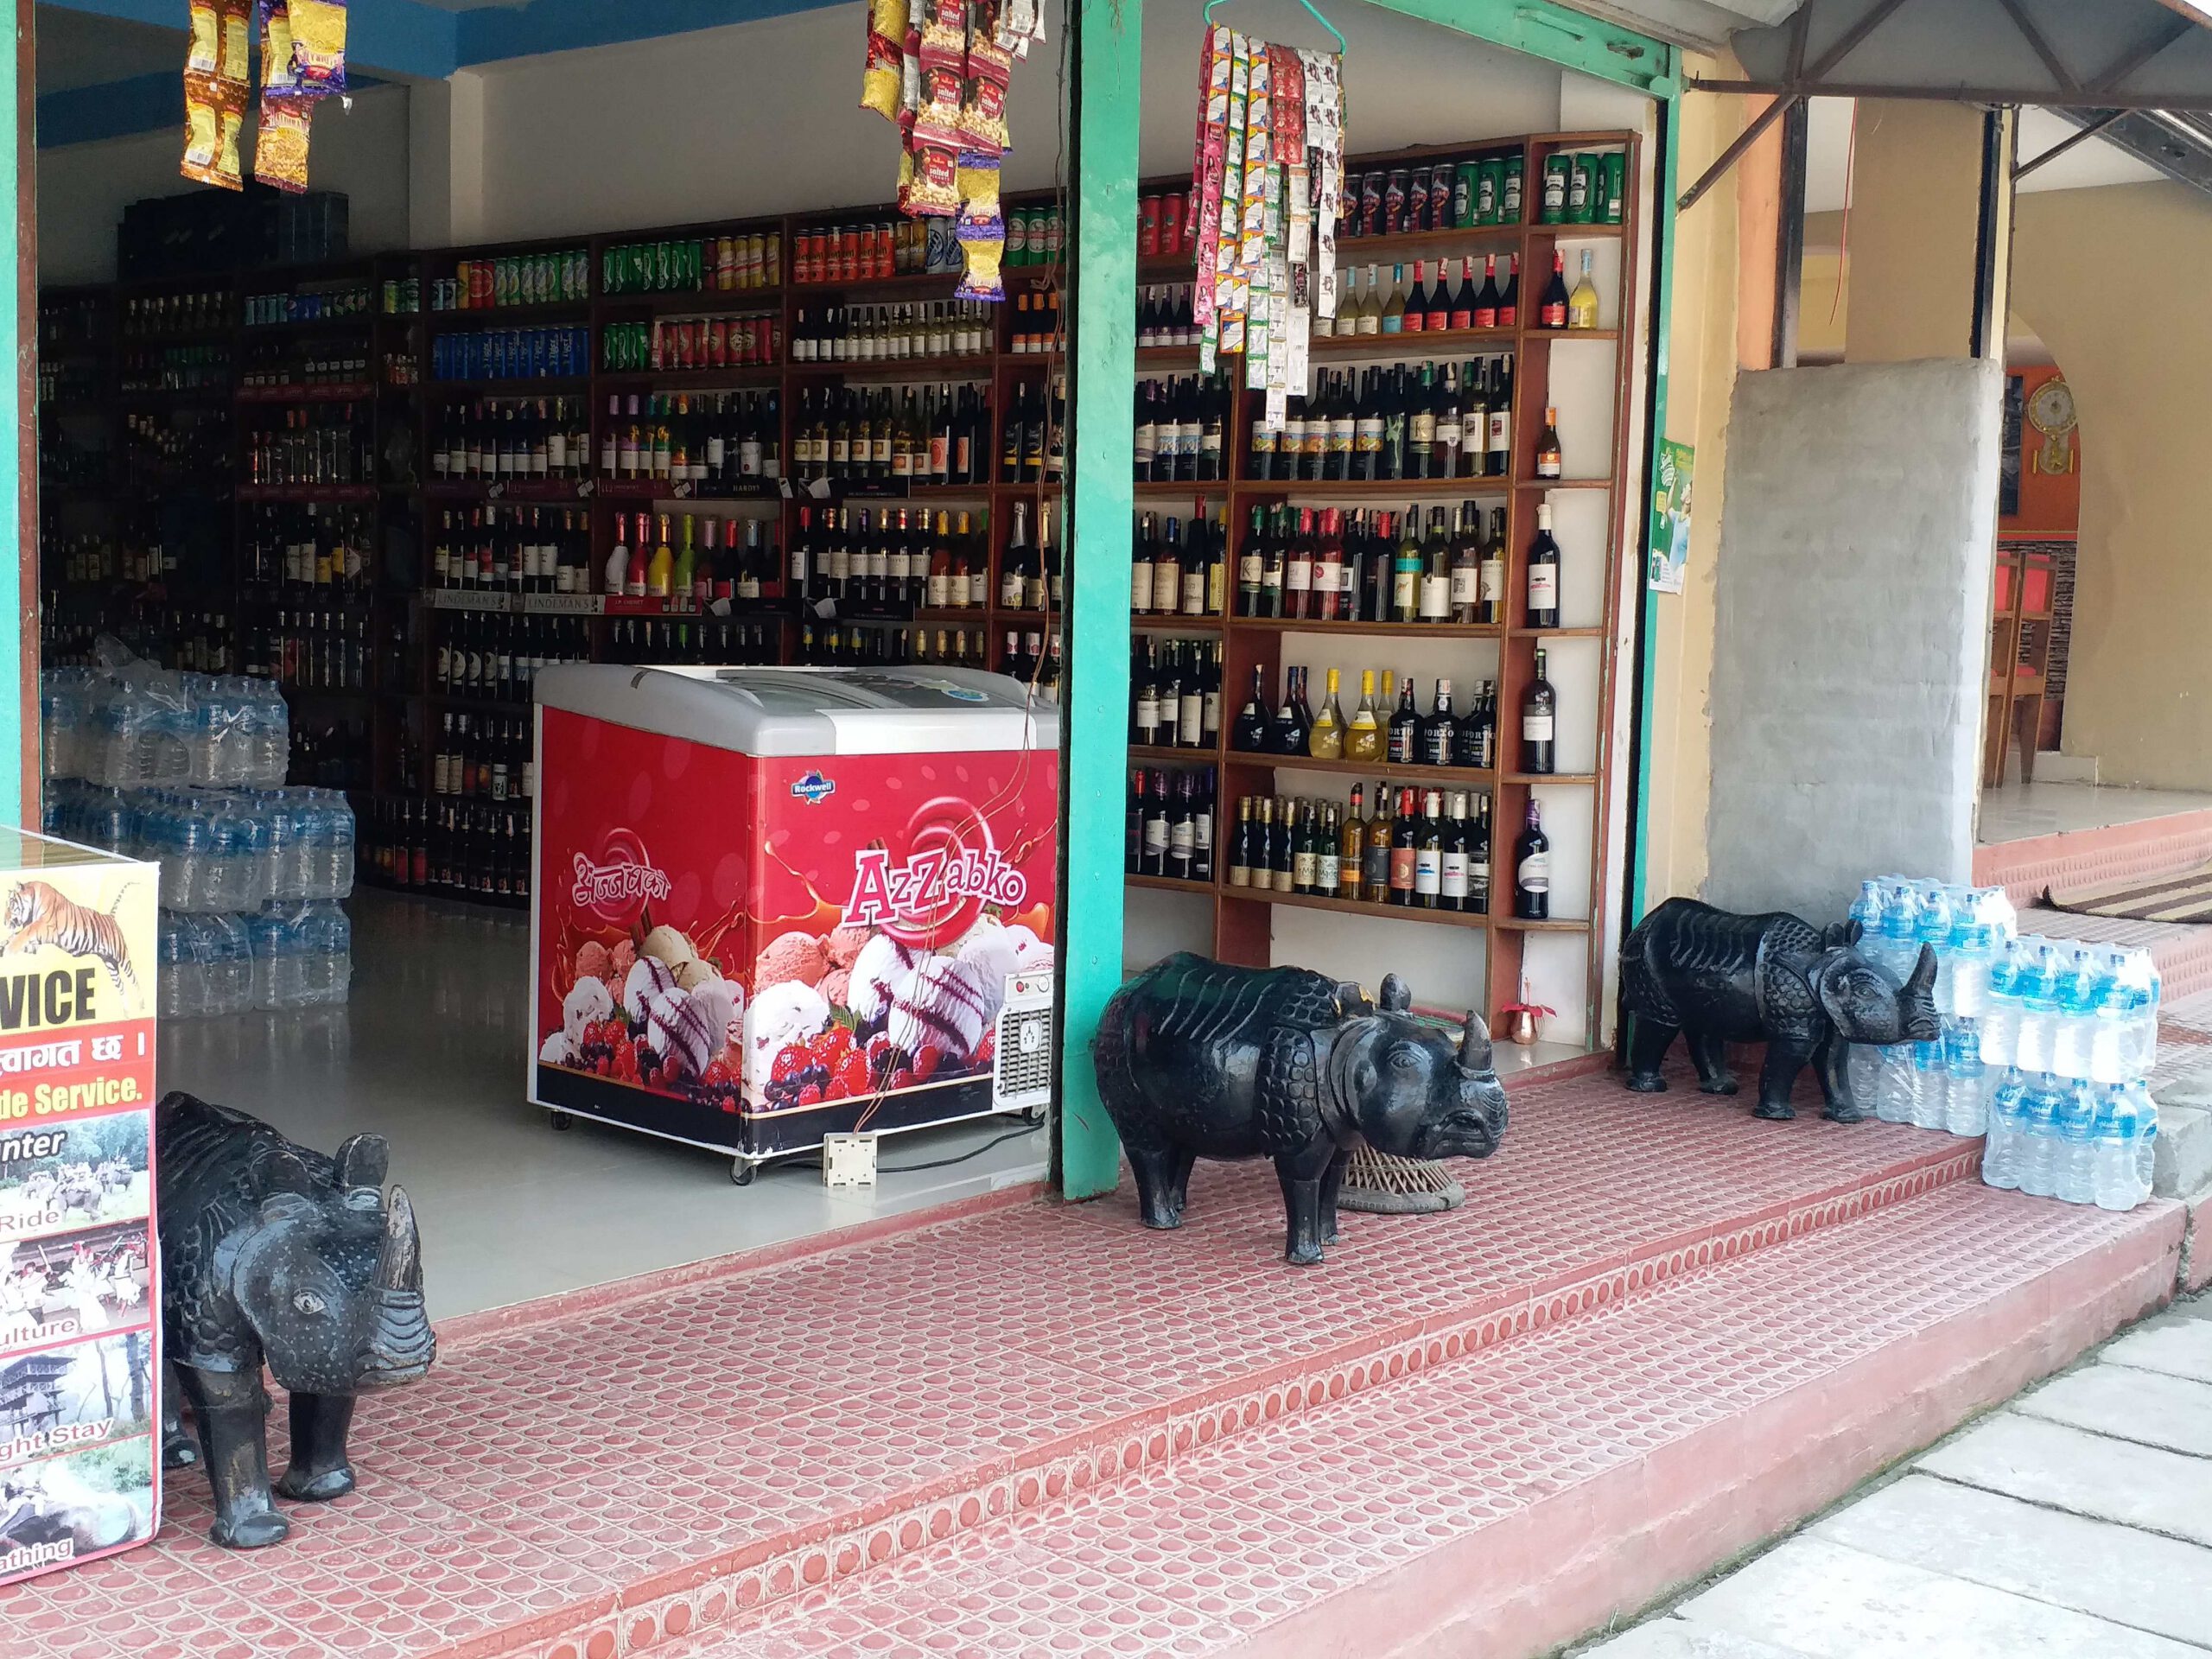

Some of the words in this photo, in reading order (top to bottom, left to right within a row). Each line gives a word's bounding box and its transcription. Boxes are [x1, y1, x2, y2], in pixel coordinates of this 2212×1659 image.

[941, 10, 960, 20] salted
[938, 88, 957, 99] salted
[982, 98, 999, 110] salted
[930, 168, 949, 177] salted
[793, 781, 832, 793] Rockwell
[0, 968, 96, 1030] VICE
[35, 1076, 143, 1115] Service.
[0, 1210, 60, 1232] Ride
[52, 1420, 111, 1445] Stay
[0, 1540, 71, 1569] athing
